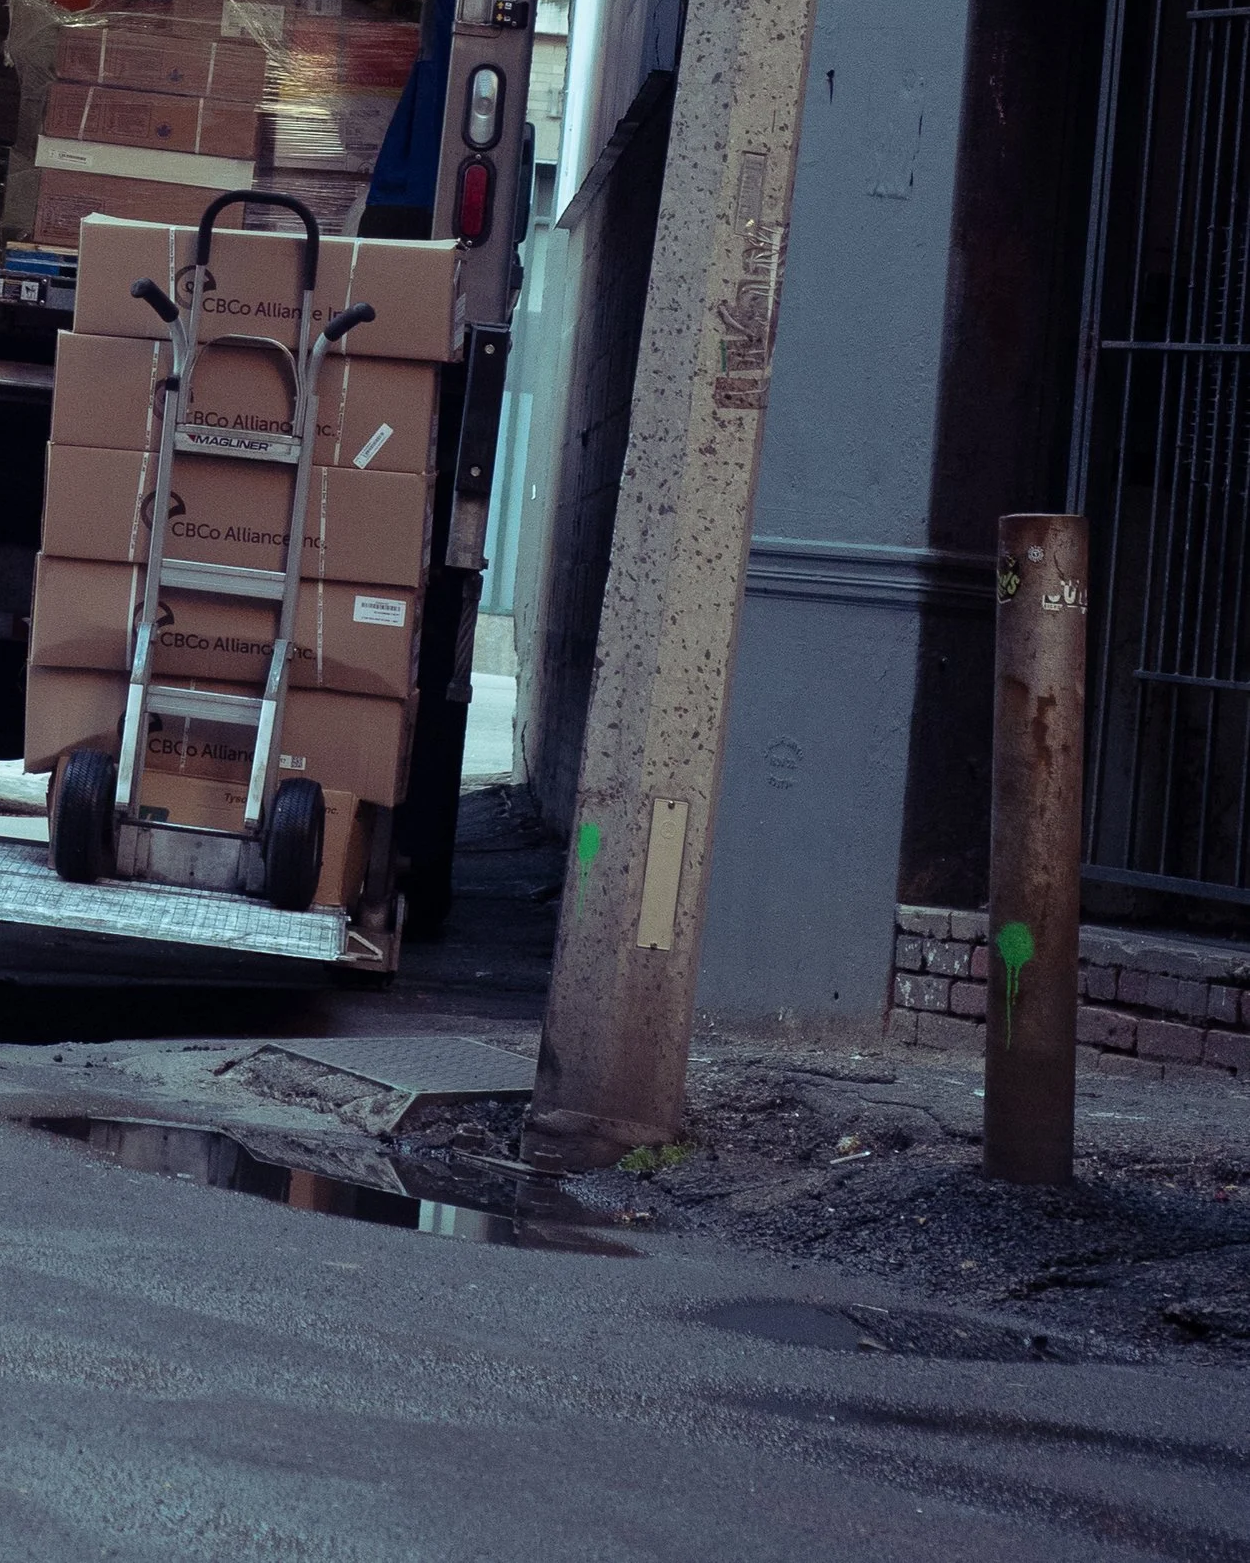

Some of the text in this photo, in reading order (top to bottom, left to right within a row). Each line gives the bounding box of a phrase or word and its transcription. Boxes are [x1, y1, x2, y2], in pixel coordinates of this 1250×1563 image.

[202, 297, 250, 316] CBCo
[255, 302, 322, 320] Alliane
[232, 414, 293, 434] Allianc
[195, 435, 269, 451] MAGLINER
[172, 522, 221, 540] CBCo
[160, 632, 209, 649] CBCo
[213, 636, 274, 656] Allianc
[224, 792, 247, 804] Tyso
